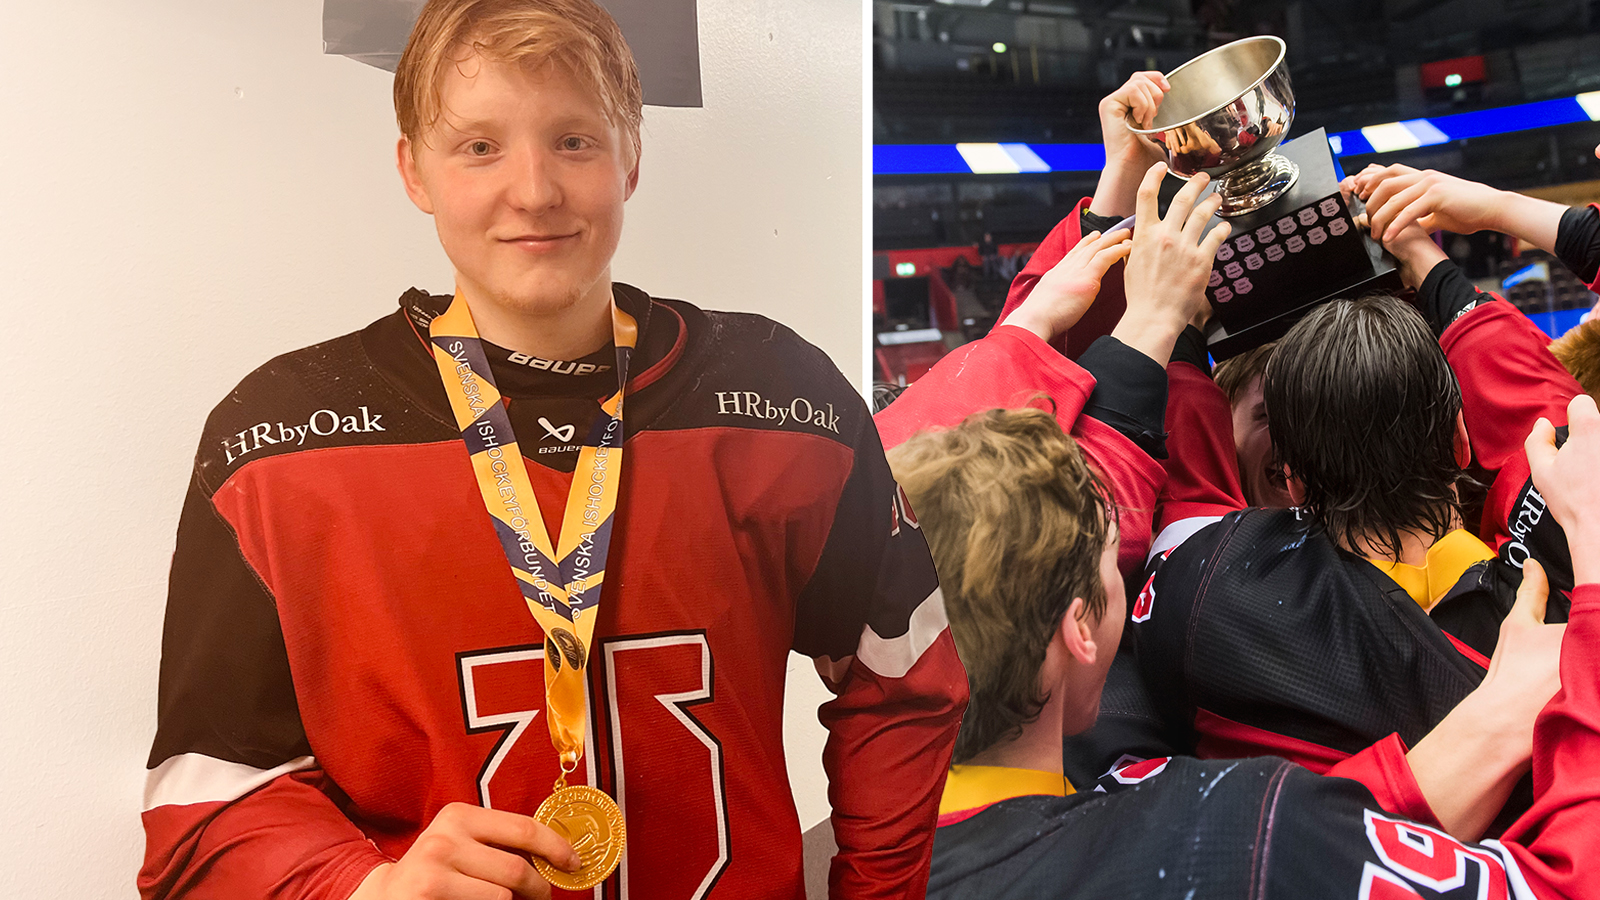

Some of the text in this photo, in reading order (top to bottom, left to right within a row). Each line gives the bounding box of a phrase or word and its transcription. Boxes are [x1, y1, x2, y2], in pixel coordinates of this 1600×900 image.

[221, 406, 385, 466] HRbyOak
[715, 390, 841, 434] HRbyOak
[448, 341, 558, 614] SVENSKA ISHOCKEYFÖRBUNDET
